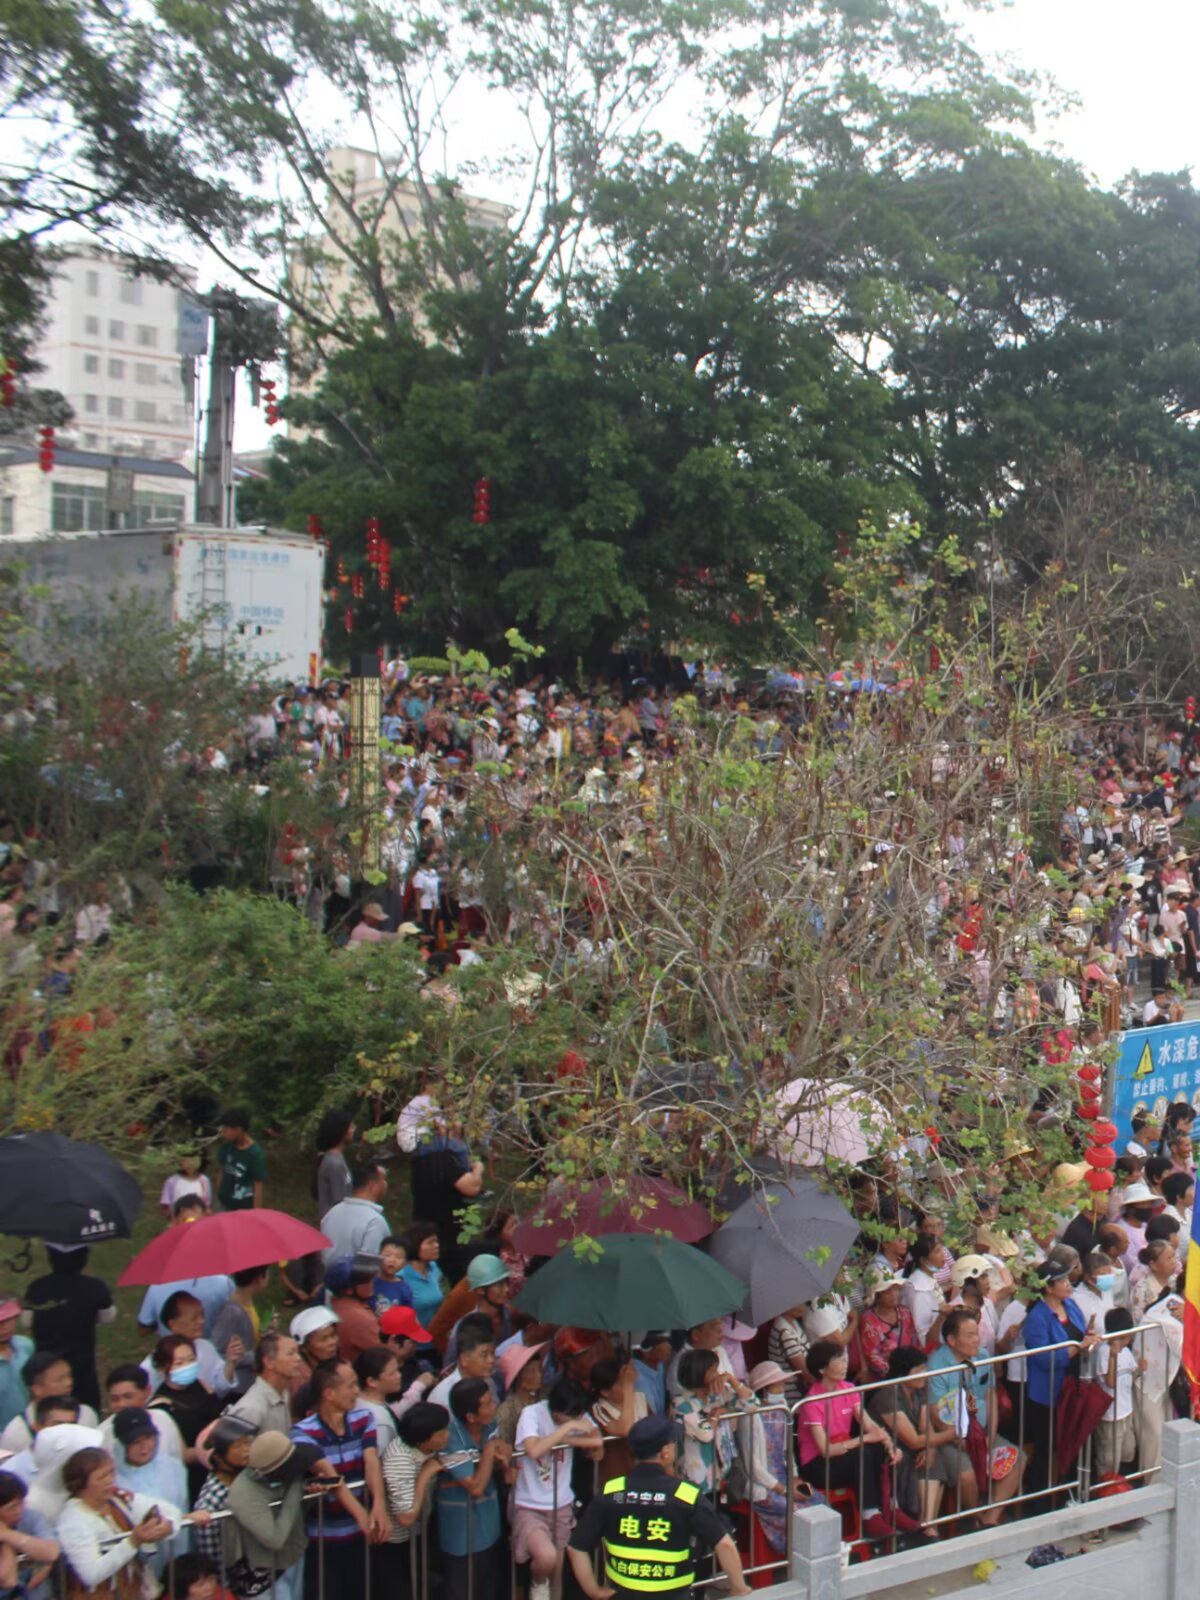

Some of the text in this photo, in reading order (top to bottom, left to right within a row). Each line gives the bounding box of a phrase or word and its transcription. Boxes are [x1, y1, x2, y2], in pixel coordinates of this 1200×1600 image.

[619, 1514, 671, 1542] 电安
[611, 1557, 676, 1577] 白保安公司
